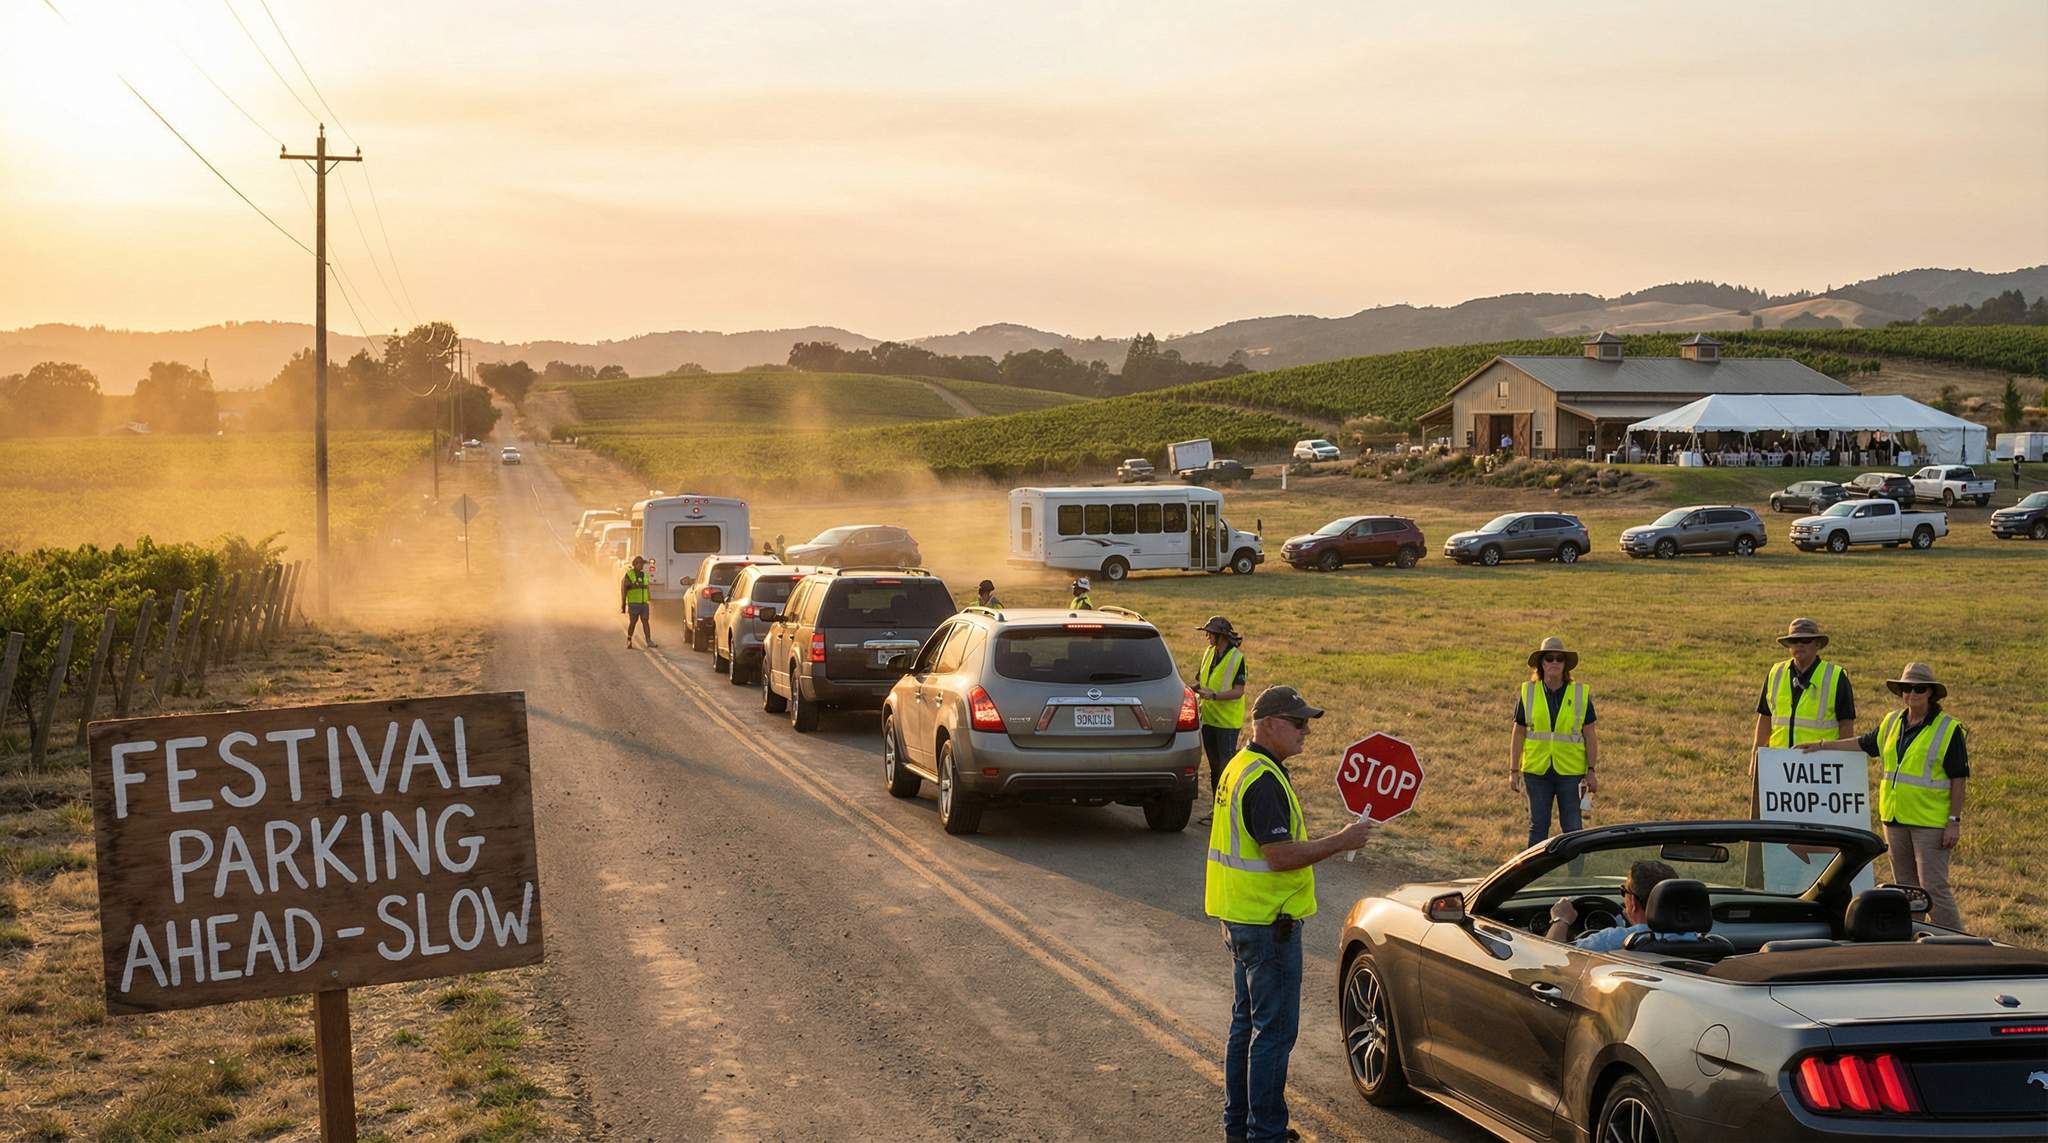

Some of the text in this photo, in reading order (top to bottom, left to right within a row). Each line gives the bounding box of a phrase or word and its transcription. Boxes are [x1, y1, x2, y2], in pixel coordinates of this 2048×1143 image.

[111, 716, 501, 818] FESTIVAL
[1344, 752, 1417, 800] STOP
[1766, 791, 1865, 814] DROP-OFF
[1783, 762, 1844, 785] VALET
[169, 803, 485, 904] PARKING
[120, 908, 323, 993] AHEAD
[377, 881, 534, 962] SLOW
